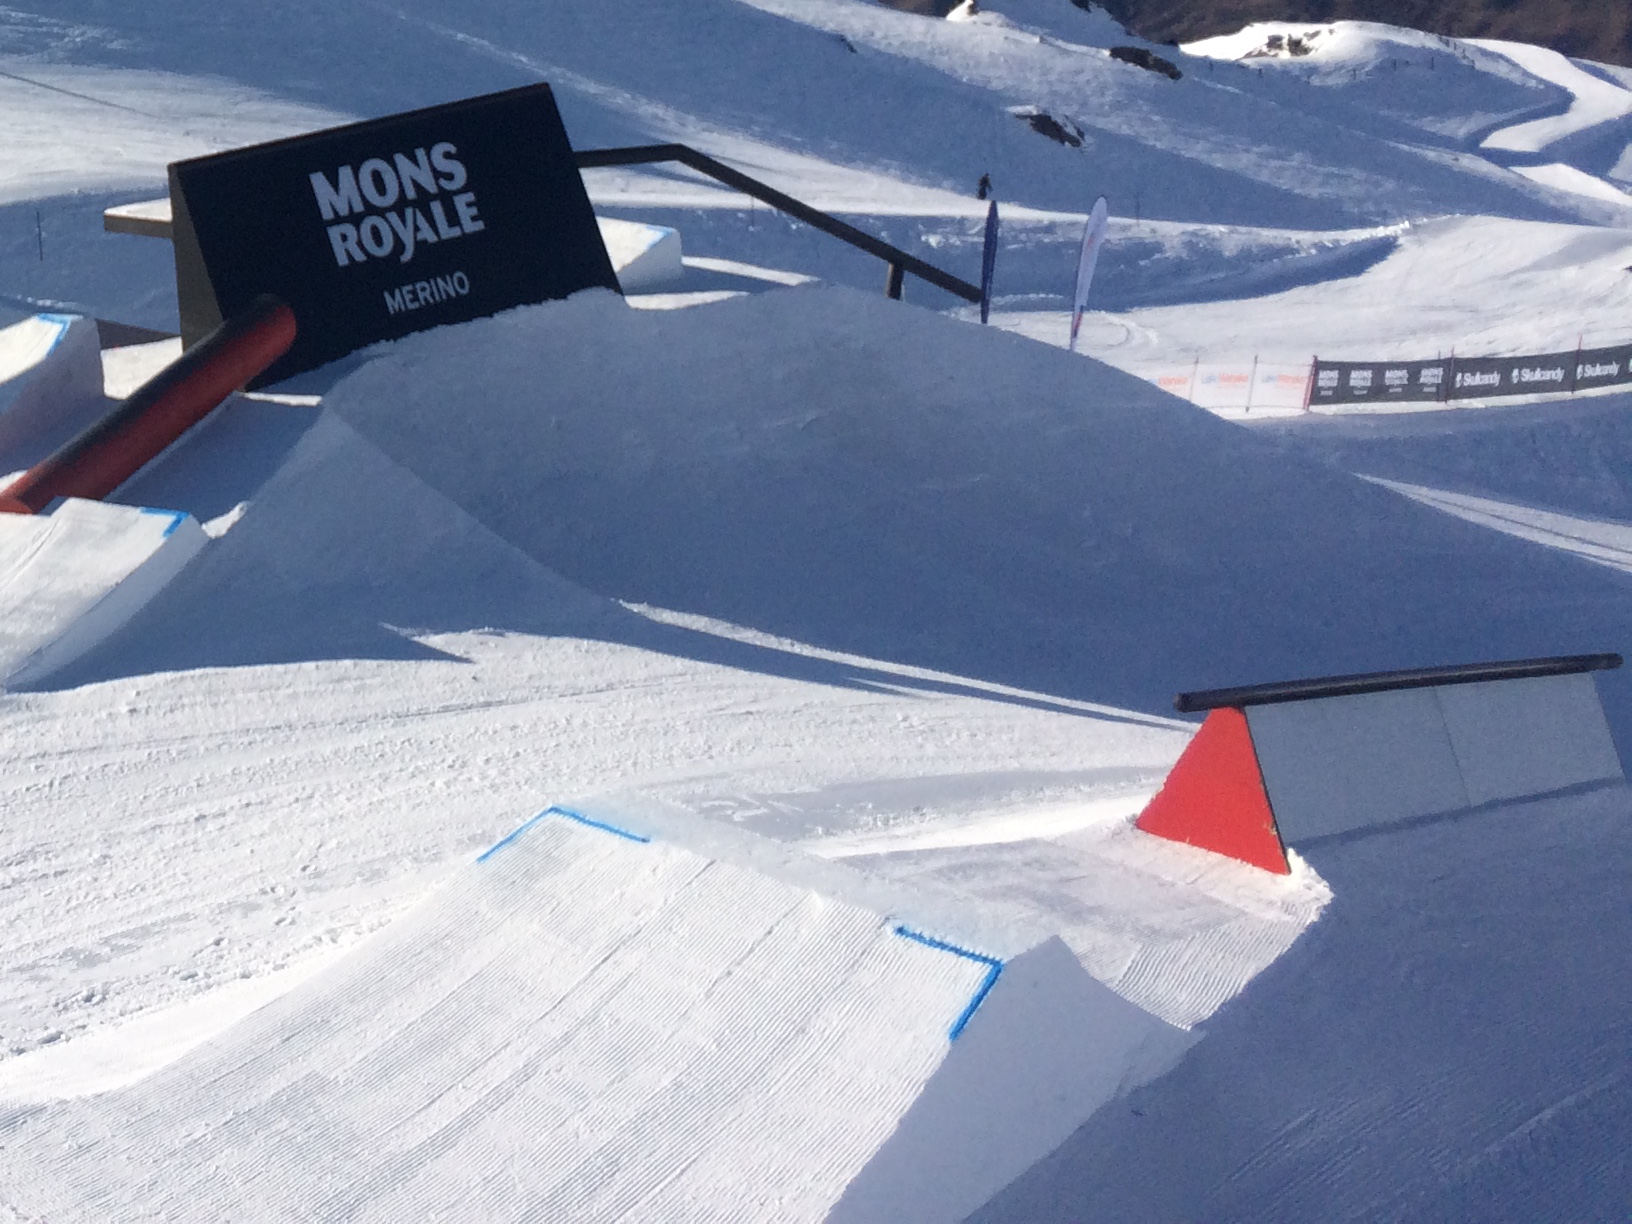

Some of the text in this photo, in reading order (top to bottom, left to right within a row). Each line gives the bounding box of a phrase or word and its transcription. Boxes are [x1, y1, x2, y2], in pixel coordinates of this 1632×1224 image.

[308, 140, 468, 222] MONS
[327, 191, 486, 268] ROYALE
[383, 271, 470, 316] MERINO
